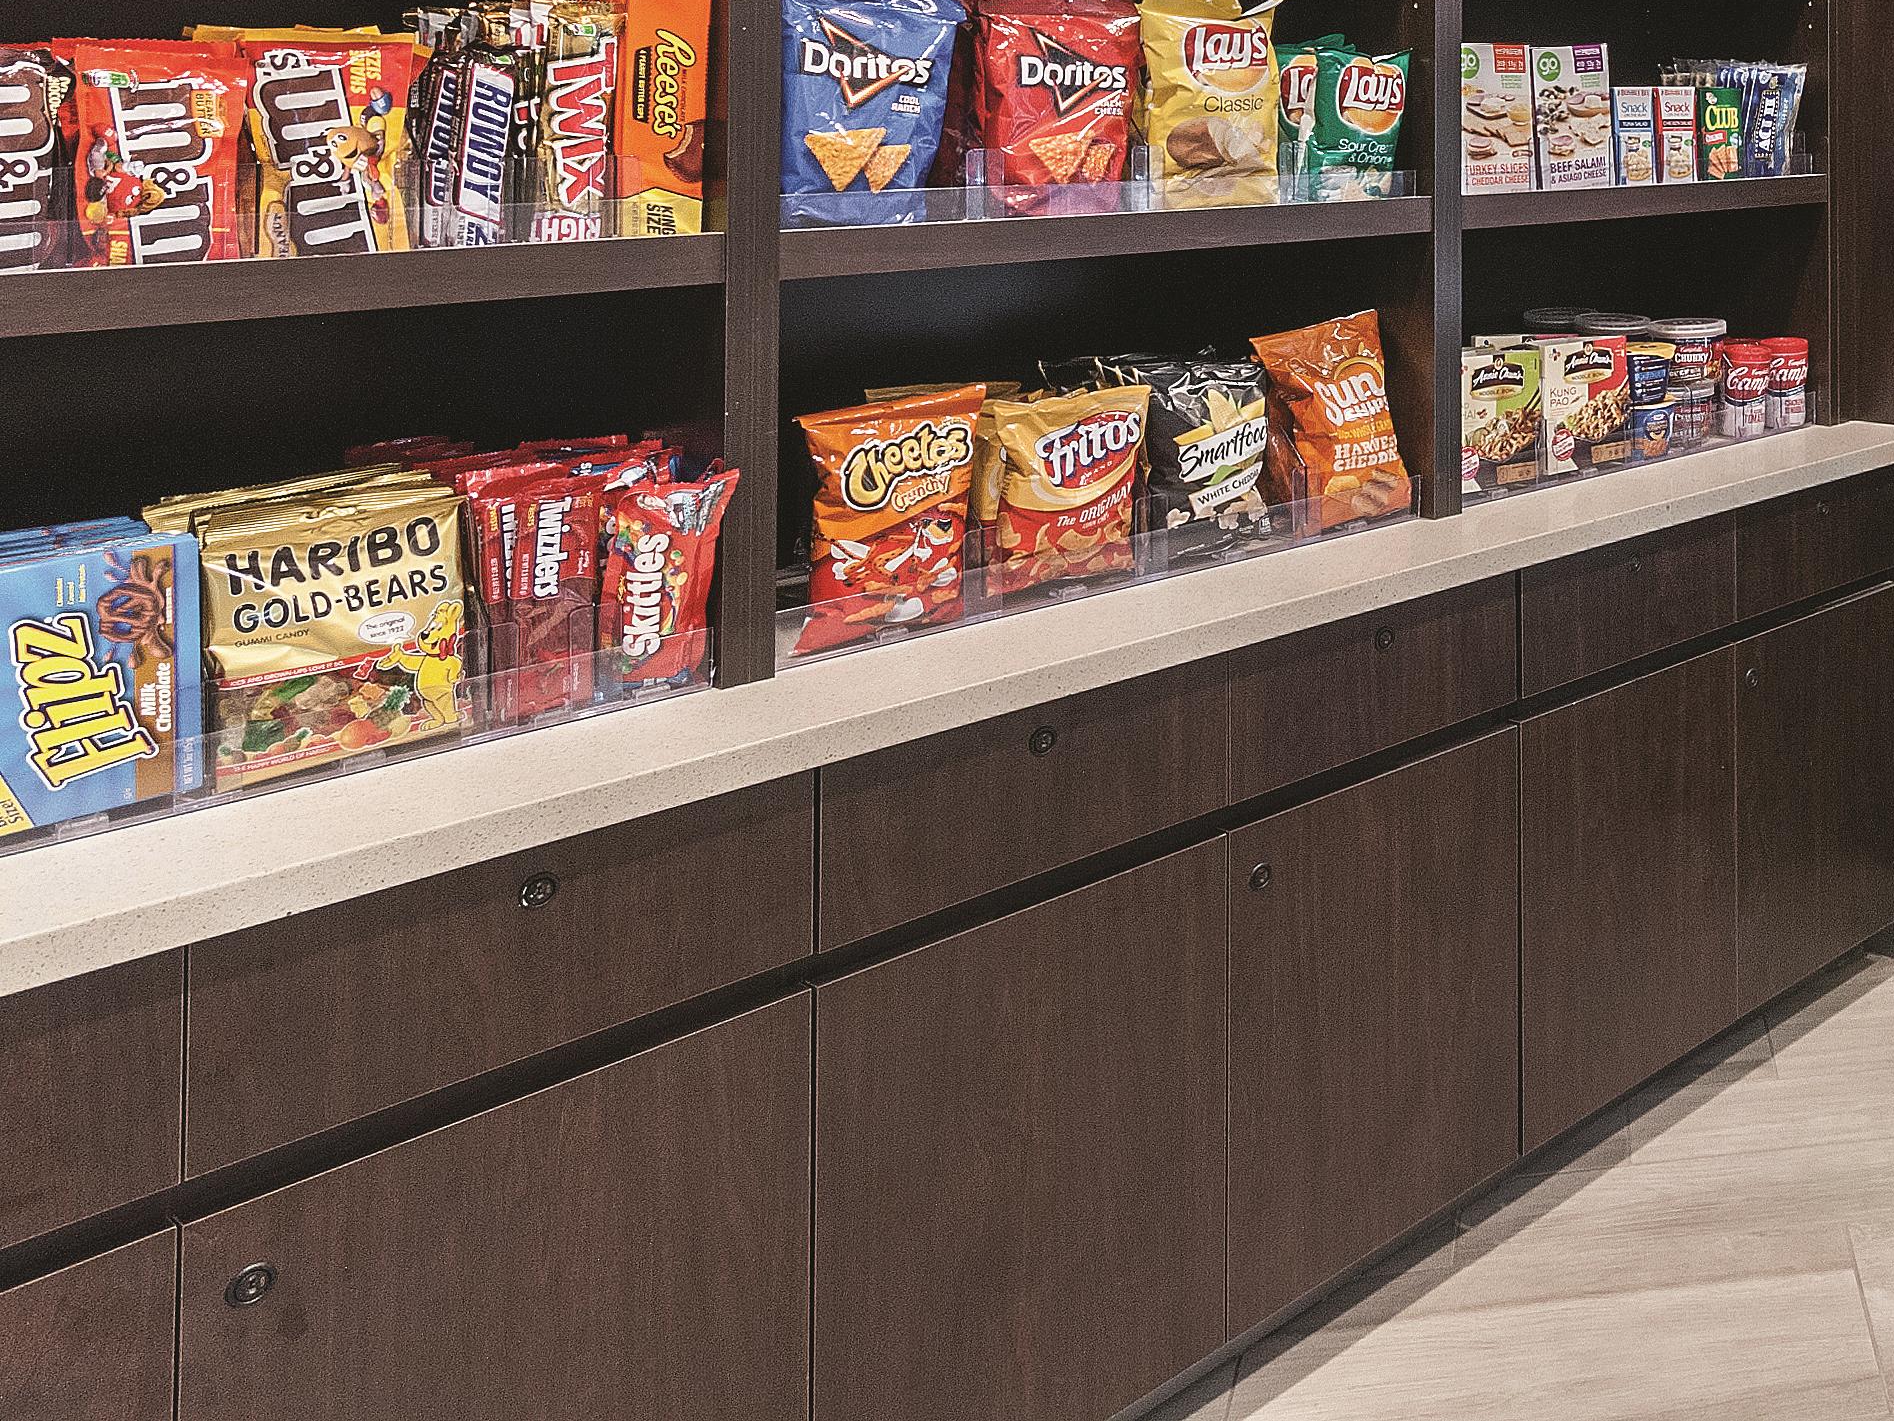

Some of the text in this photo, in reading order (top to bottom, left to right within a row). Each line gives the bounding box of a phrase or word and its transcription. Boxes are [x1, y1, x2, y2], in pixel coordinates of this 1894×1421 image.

[803, 40, 934, 85] Doritos
[1191, 27, 1268, 71] Lay's
[1020, 55, 1127, 88] Doritos
[1539, 57, 1558, 75] go
[653, 29, 696, 139] Reese's
[1343, 66, 1403, 111] Lay's
[898, 94, 921, 106] COOL
[1204, 94, 1264, 113] Classic
[1621, 101, 1648, 114] Snack
[1664, 101, 1691, 113] Snack
[547, 37, 619, 207] TWIX
[1705, 104, 1739, 131] CLUB
[463, 82, 513, 206] ROWDY
[1338, 138, 1367, 153] Sour
[1758, 119, 1774, 153] ACT
[1348, 152, 1389, 165] & Onion
[1500, 162, 1529, 174] SLICES
[1551, 156, 1606, 174] BEEF SALAMI
[1471, 174, 1529, 186] CHEDDAR CHEESE
[1558, 168, 1607, 184] ASIAGO CHEESE
[646, 203, 663, 235] SIZE
[661, 205, 678, 236] KING
[1674, 352, 1709, 364] CHUNKY
[1315, 372, 1385, 426] Sun
[1550, 387, 1577, 396] KUNG
[1550, 398, 1569, 407] PAO
[1035, 412, 1142, 486] Fritos
[844, 428, 971, 508] Cheetos
[893, 476, 951, 511] Crunchy
[1197, 486, 1231, 505] WHITE
[1056, 515, 1077, 528] The
[224, 515, 441, 596] HARIBO
[533, 495, 572, 599] Twizzlers
[231, 564, 449, 635] GOLD-BEARS
[622, 533, 671, 657] Skittles
[234, 628, 310, 649] GUMMI CANDY
[380, 617, 406, 629] original
[13, 616, 153, 787] Flipz
[140, 683, 157, 717] Milk
[156, 662, 172, 732] Chocolate
